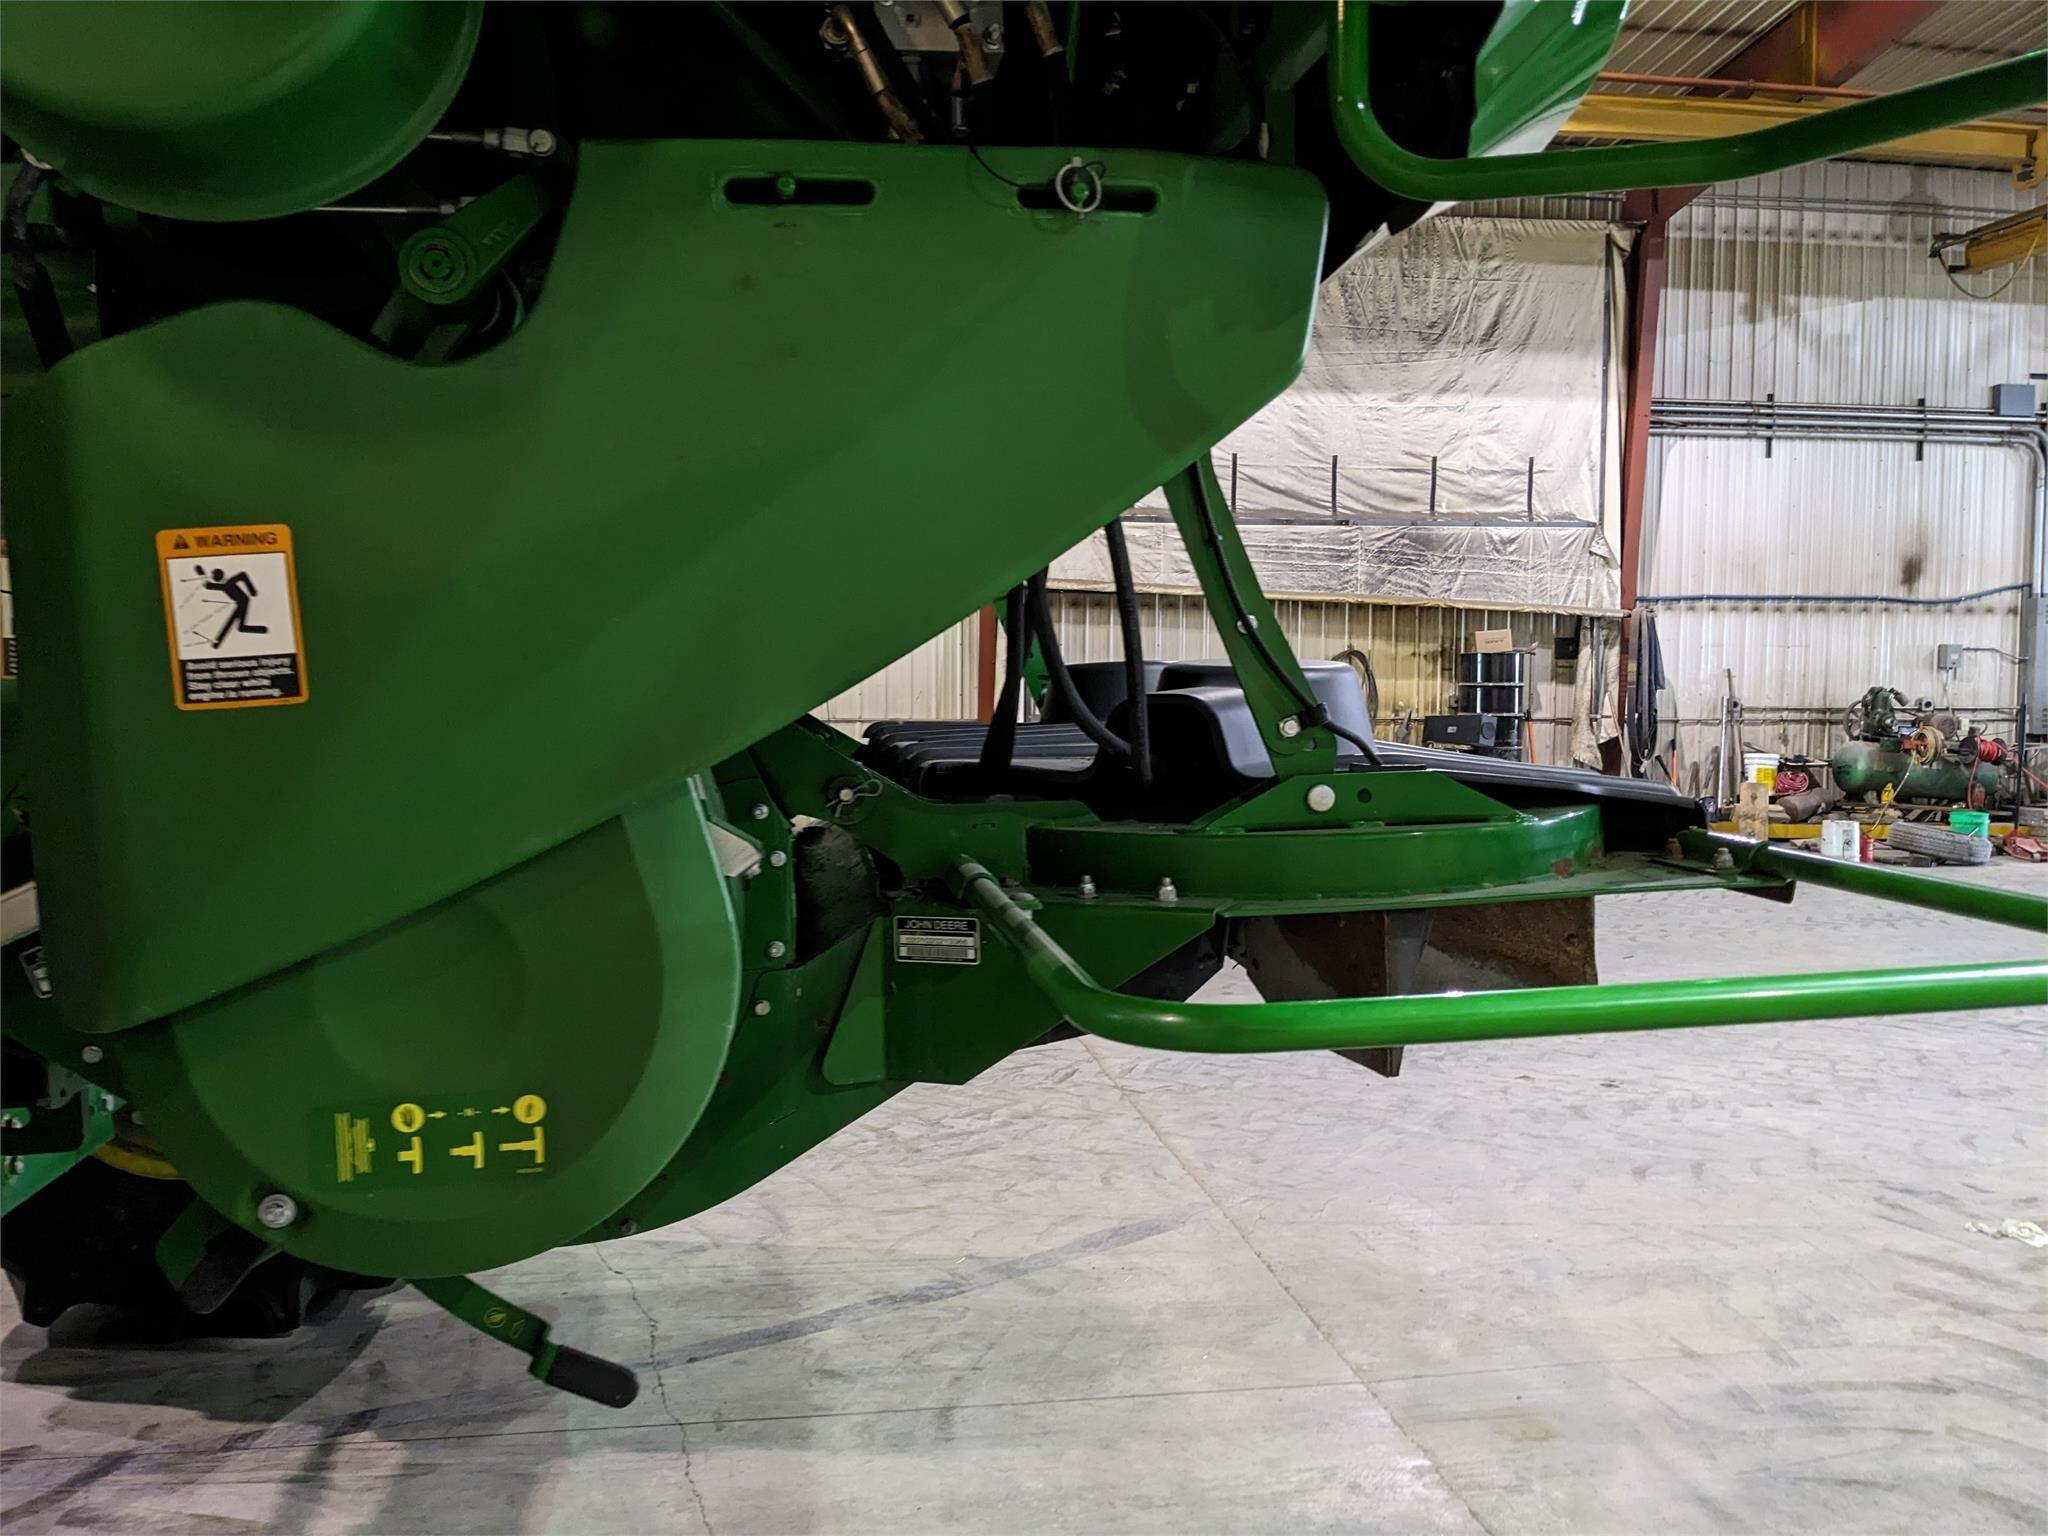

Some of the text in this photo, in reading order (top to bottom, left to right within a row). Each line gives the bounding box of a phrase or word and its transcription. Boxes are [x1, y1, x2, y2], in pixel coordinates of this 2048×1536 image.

[193, 531, 278, 548] WARNING
[904, 919, 969, 931] JOHN DEERE
